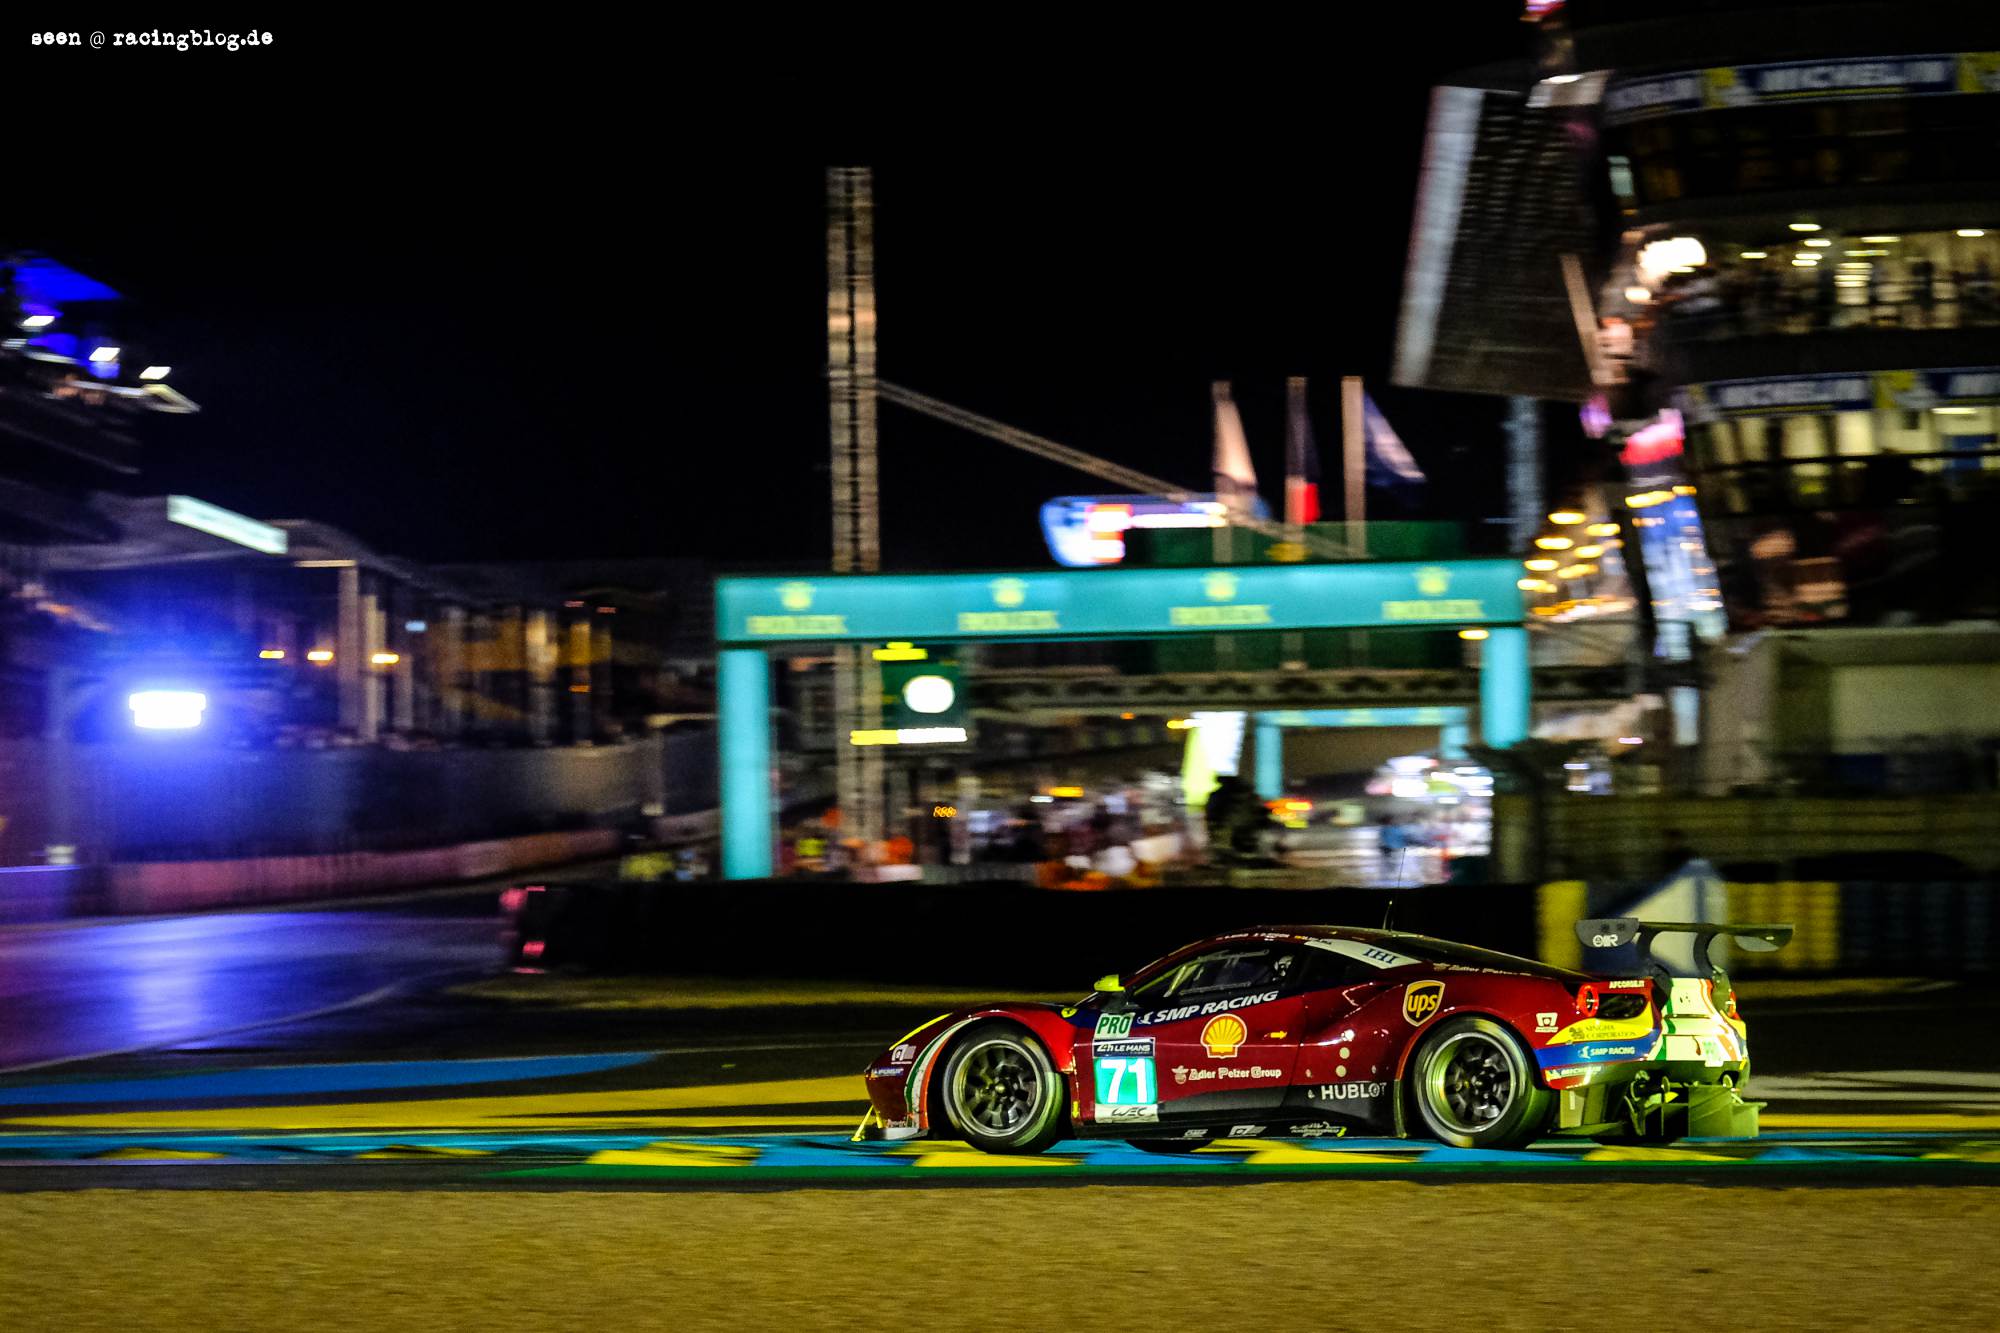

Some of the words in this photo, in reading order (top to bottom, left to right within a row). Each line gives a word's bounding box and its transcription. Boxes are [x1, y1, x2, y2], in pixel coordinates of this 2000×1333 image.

[1153, 1004, 1200, 1024] SMP
[1200, 990, 1280, 1016] RACING
[1407, 993, 1439, 1019] ups
[1096, 1016, 1131, 1035] PRO
[1100, 1058, 1149, 1104] 71
[1188, 1068, 1216, 1081] Adler
[1217, 1066, 1250, 1080] Pelzer
[1250, 1066, 1282, 1079] Group
[1320, 1081, 1388, 1101] HUBLOT
[1111, 1106, 1148, 1118] WEC
